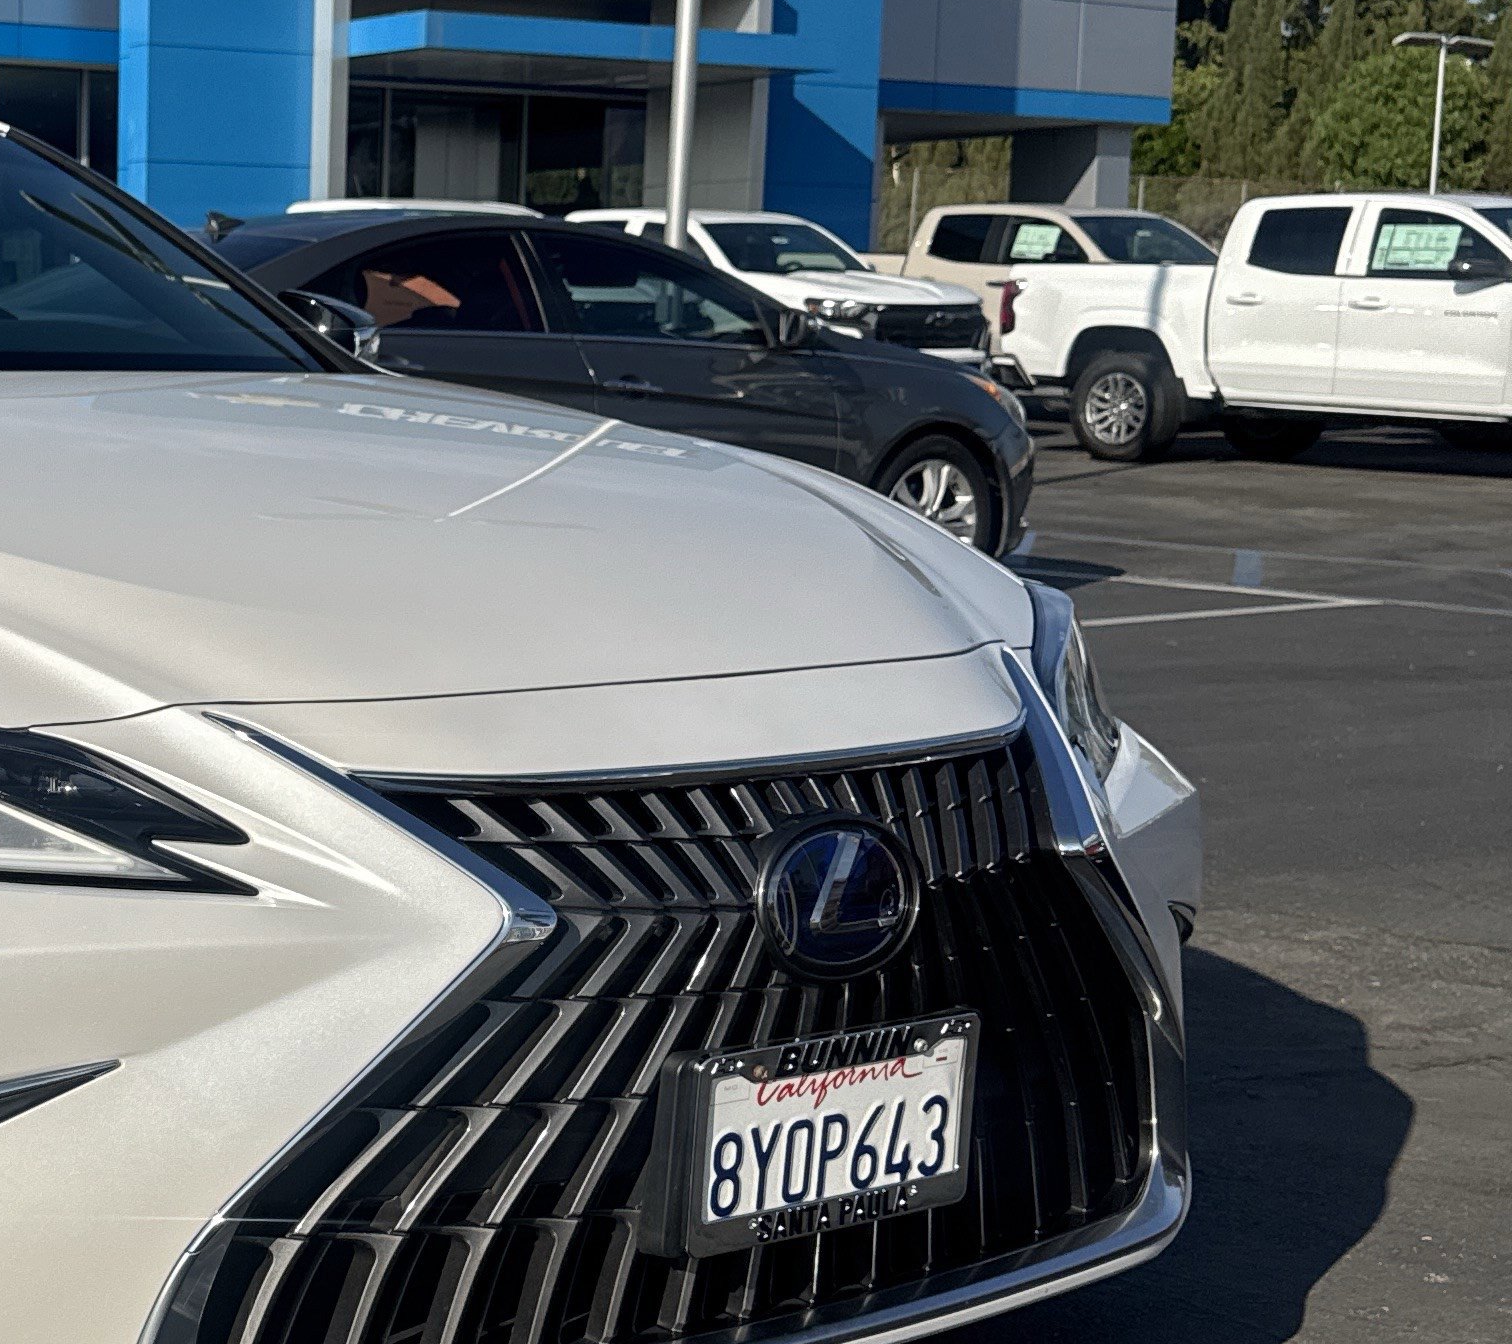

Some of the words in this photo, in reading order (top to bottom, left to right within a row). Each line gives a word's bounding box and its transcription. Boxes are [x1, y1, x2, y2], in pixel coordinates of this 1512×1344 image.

[774, 1025, 914, 1079] BUNNIN
[756, 1057, 923, 1110] California
[709, 1094, 949, 1218] 8YOP643
[755, 1201, 832, 1243] SANTA
[838, 1185, 909, 1226] PAULA
